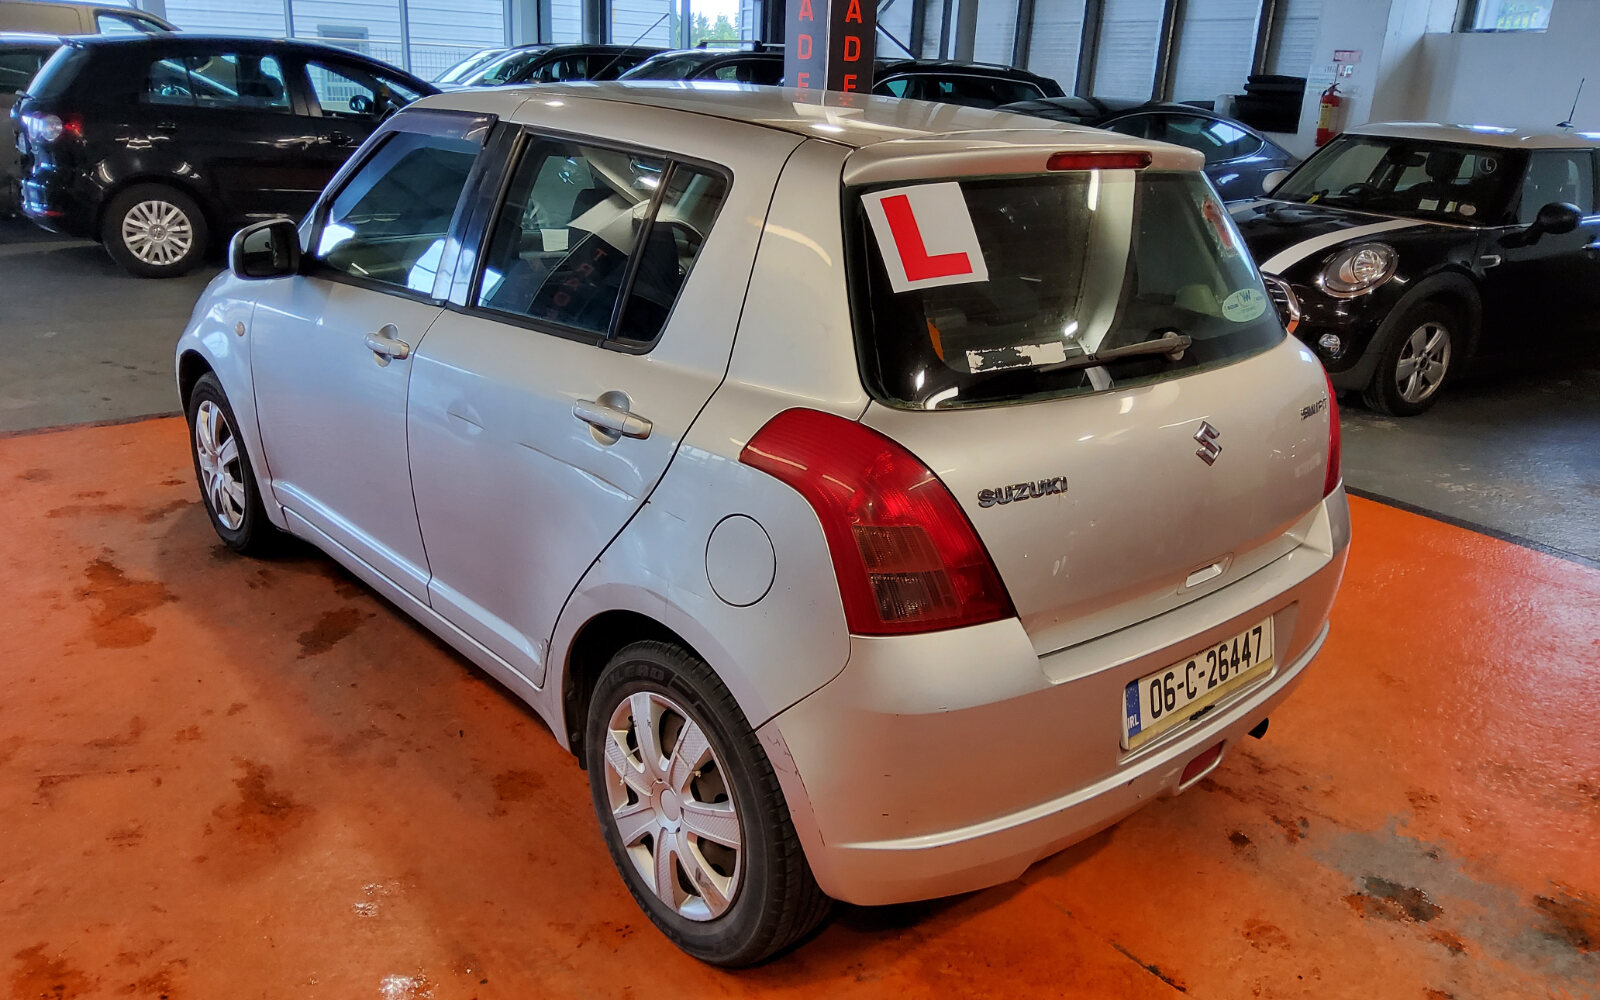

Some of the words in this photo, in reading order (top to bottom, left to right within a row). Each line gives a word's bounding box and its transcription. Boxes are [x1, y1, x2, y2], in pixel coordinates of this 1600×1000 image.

[880, 194, 973, 281] L
[978, 476, 1068, 508] SUZUKI
[1150, 626, 1262, 719] 06-C-26447
[1127, 713, 1140, 729] IRL
